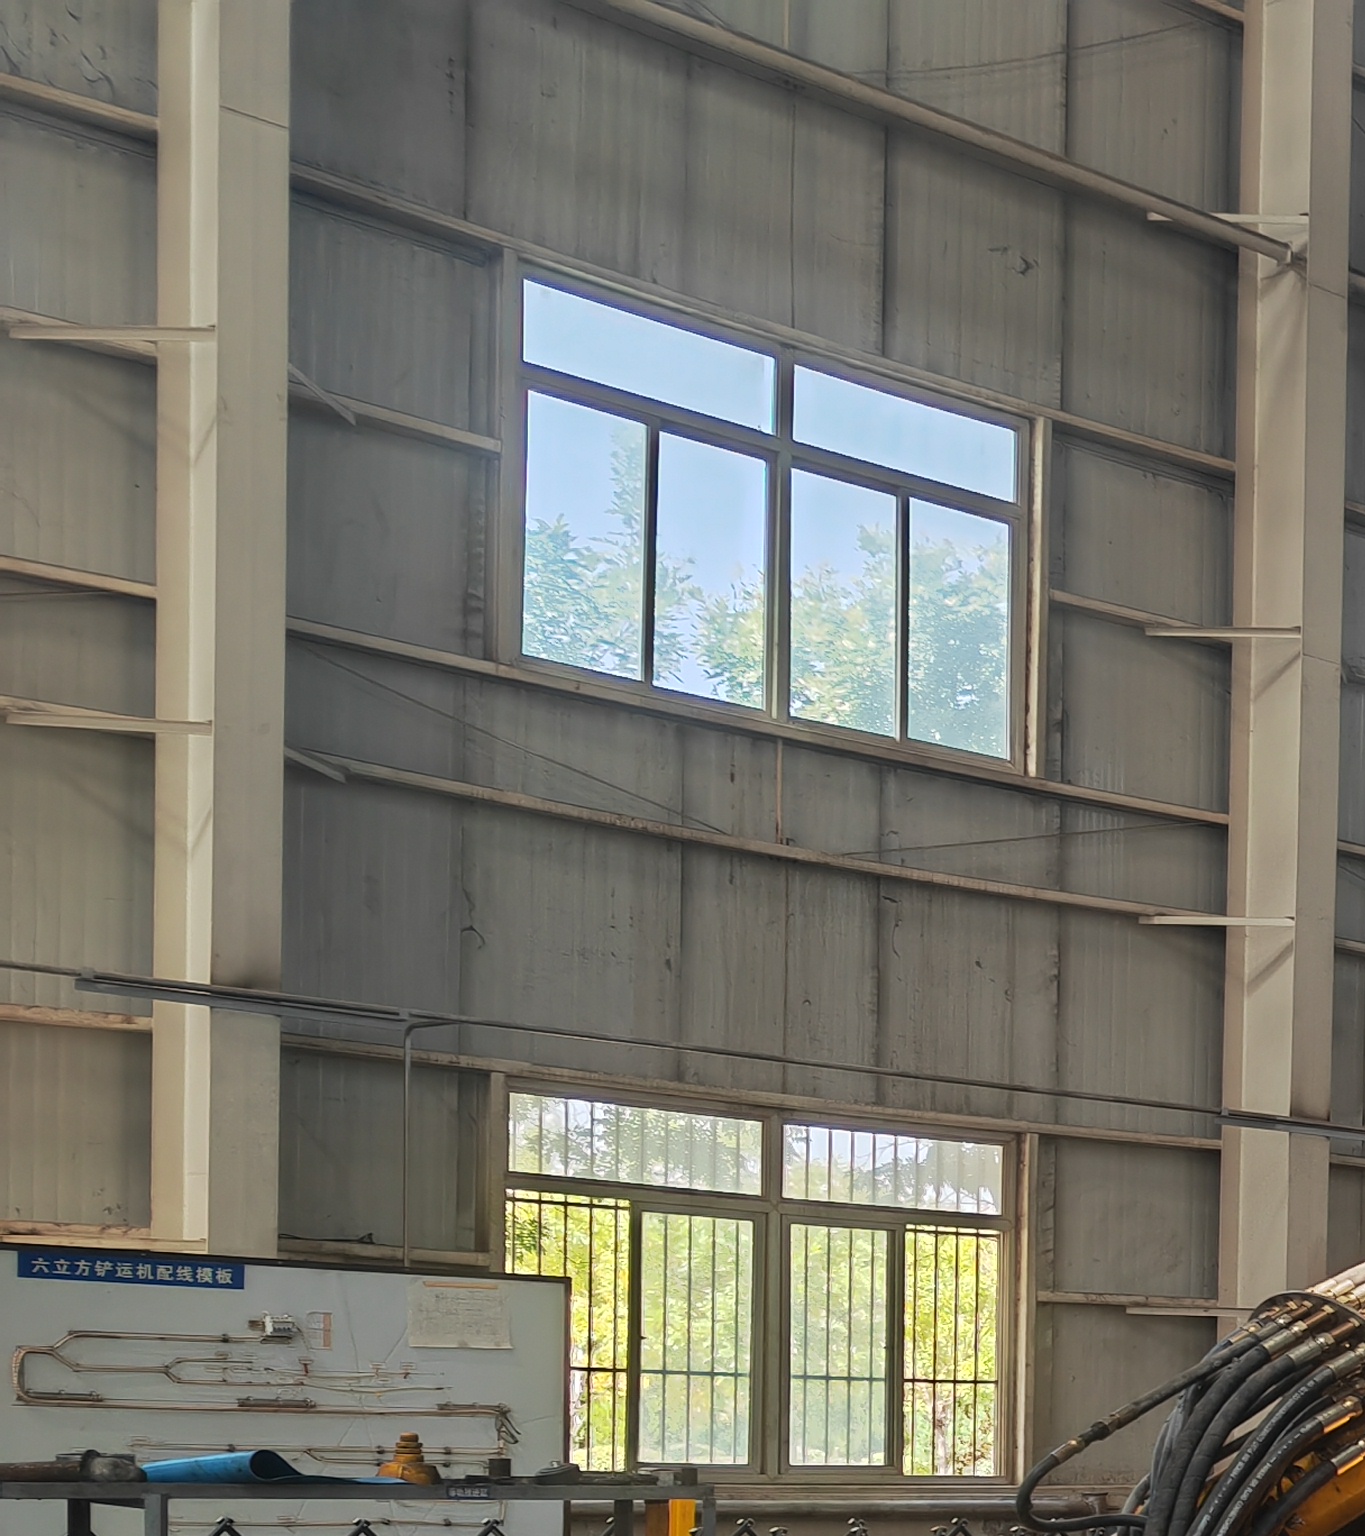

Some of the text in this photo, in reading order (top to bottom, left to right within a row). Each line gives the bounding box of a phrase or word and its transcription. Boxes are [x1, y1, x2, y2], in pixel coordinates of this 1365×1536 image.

[31, 1257, 234, 1285] 六立方铲运机配线模板
